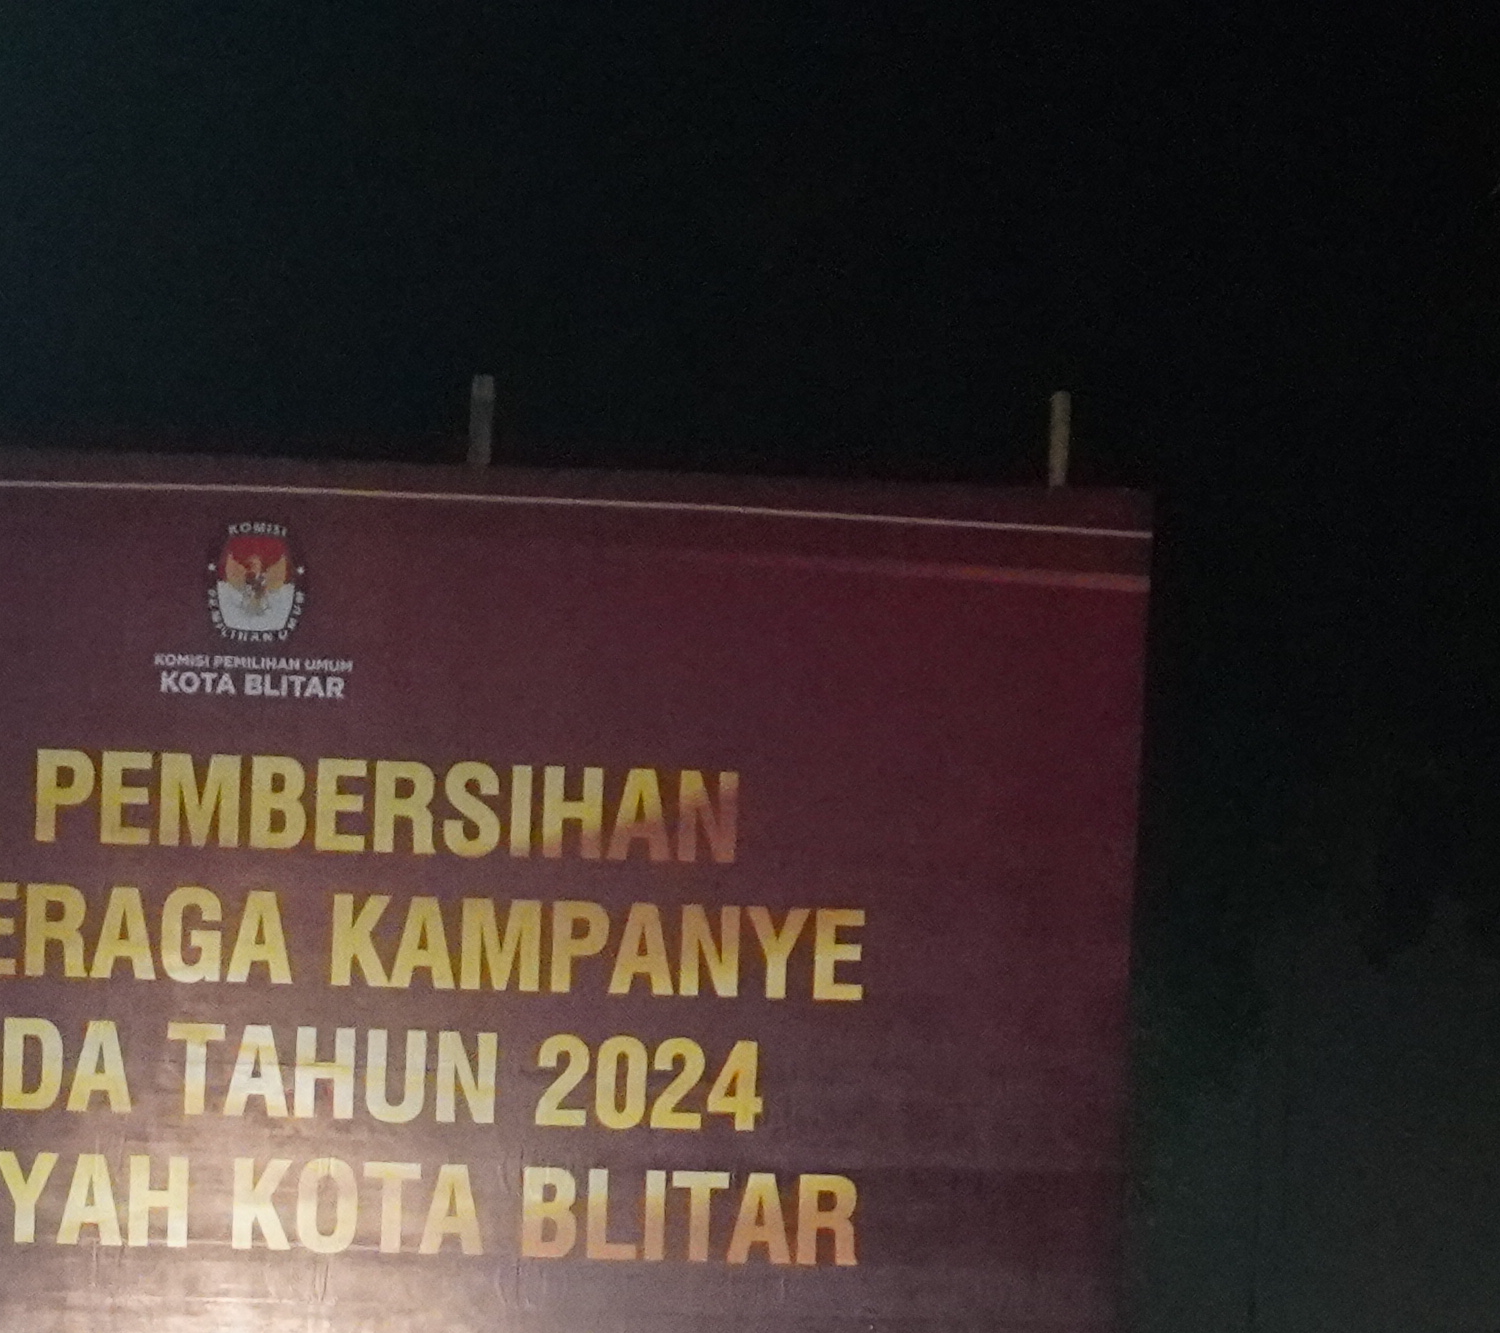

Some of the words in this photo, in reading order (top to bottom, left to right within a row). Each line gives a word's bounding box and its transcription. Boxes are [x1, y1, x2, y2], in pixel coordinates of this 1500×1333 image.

[154, 653, 209, 667] KOMISI
[213, 655, 300, 670] PEMILIHAN
[304, 658, 353, 672] UMUM
[160, 670, 236, 694] KOTA
[244, 673, 345, 698] BLITAR
[34, 747, 739, 863] PEMBERSIHAN
[330, 892, 866, 1002] KAMPANYE
[167, 1021, 498, 1125] TAHUN
[534, 1033, 763, 1132] 2024
[231, 1157, 484, 1257] KOTA
[521, 1165, 858, 1268] BLITAR
